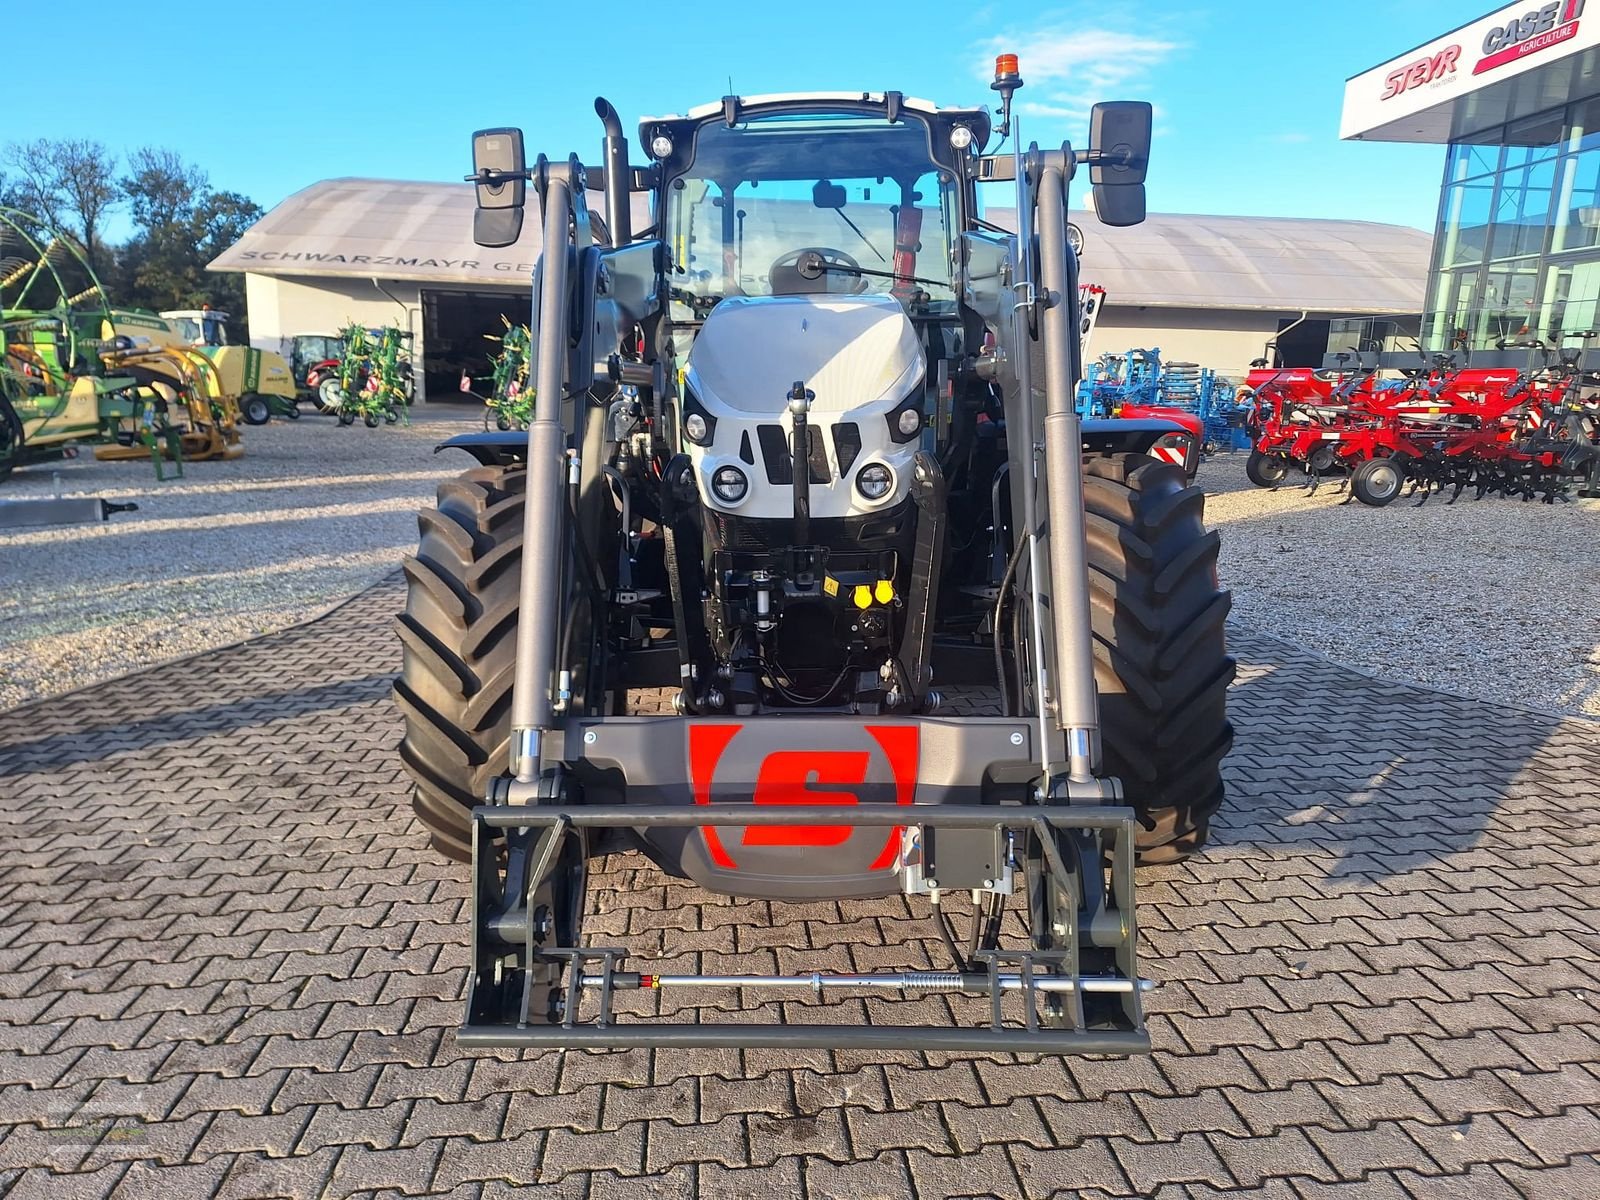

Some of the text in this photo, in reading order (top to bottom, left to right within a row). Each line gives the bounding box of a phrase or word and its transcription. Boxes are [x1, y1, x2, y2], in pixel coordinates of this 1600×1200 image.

[1482, 1, 1560, 55] CASE
[1518, 25, 1572, 54] AGRICULTURE
[1380, 44, 1462, 101] STEYR
[240, 251, 534, 273] SCHWARZMAYR GE
